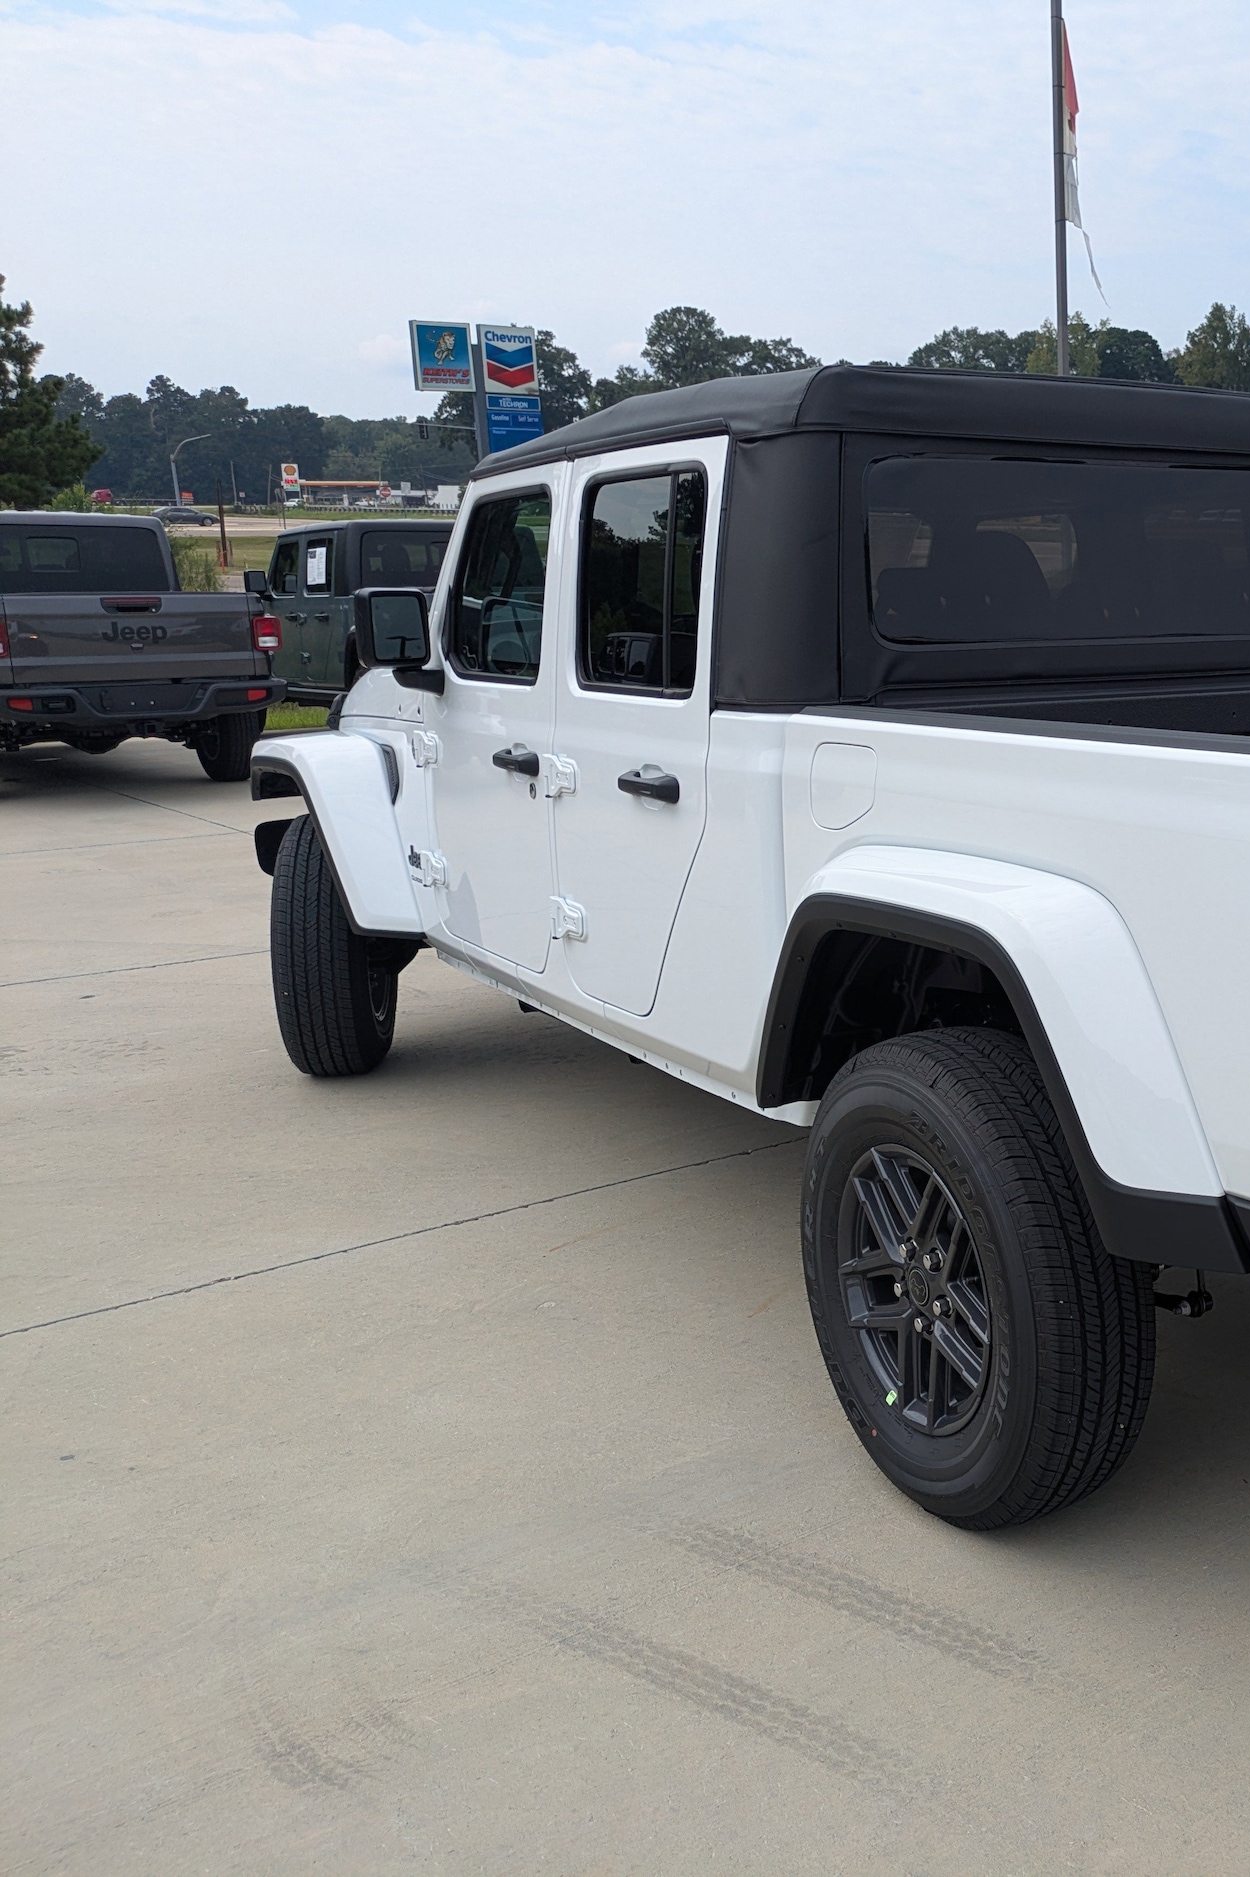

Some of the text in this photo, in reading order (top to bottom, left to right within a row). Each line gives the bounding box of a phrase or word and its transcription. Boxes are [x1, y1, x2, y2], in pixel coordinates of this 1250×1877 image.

[484, 330, 532, 344] Chevron
[423, 368, 470, 377] KEITH'S
[422, 377, 470, 385] SUPERSTORES
[499, 399, 528, 408] TECHRON
[101, 621, 168, 644] Jeep
[904, 1109, 1012, 1440] BRIDGESTONE
